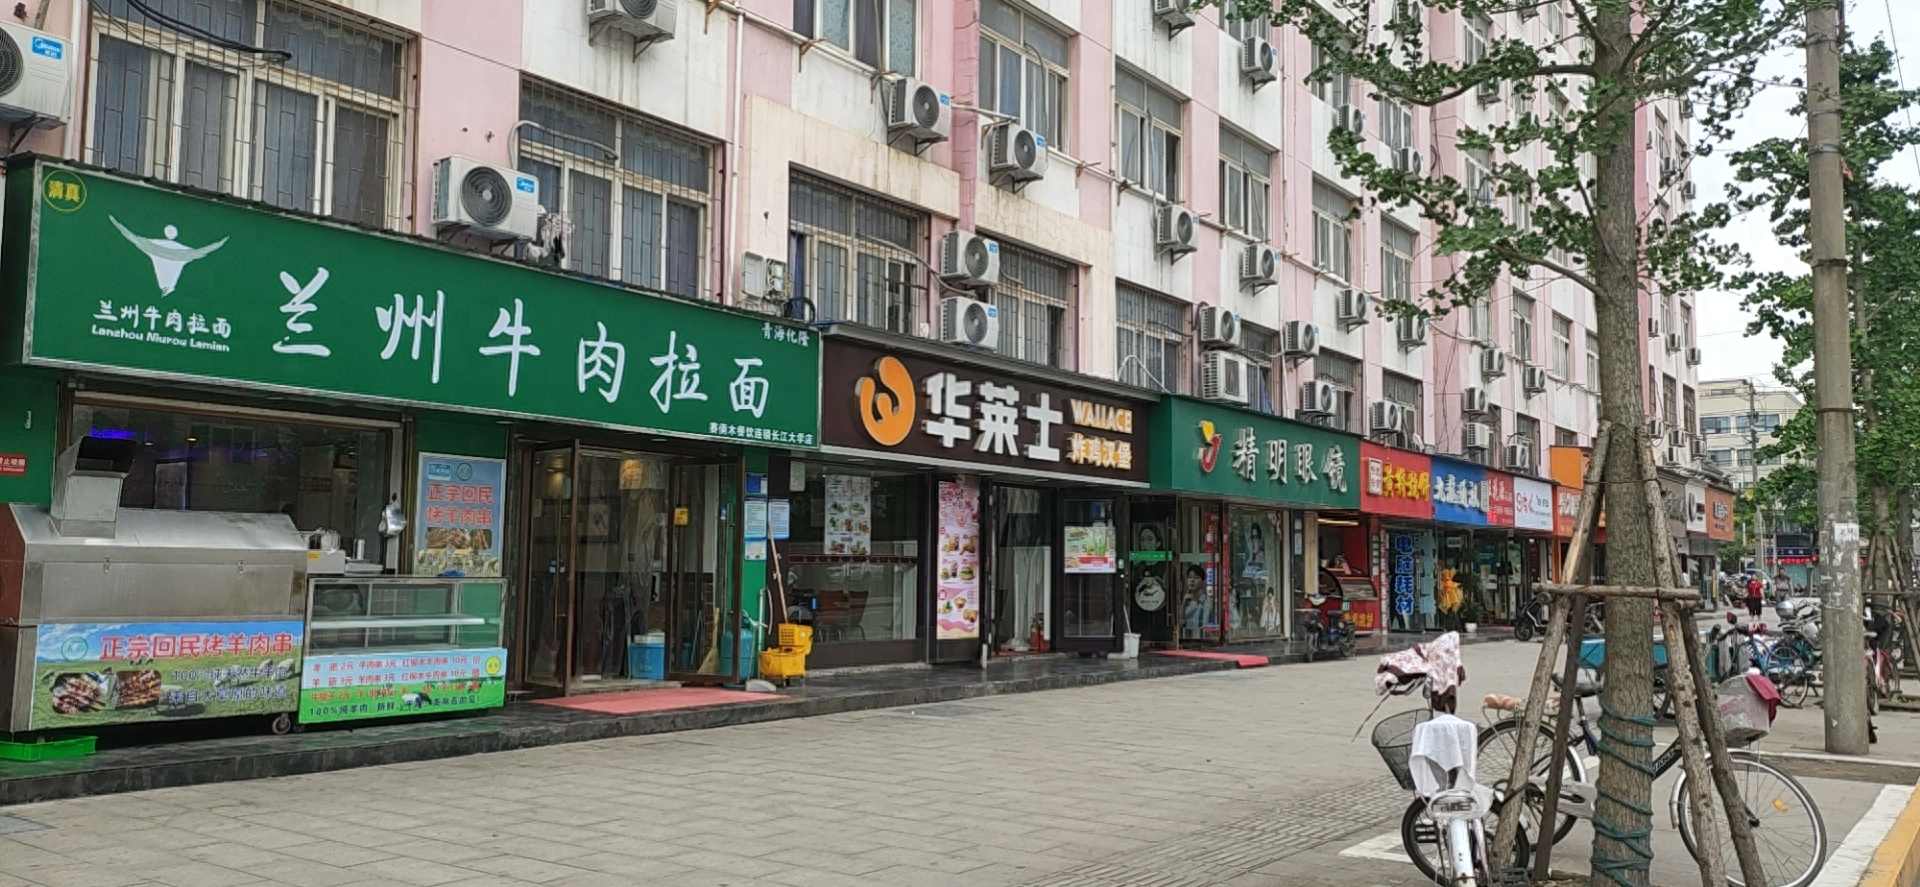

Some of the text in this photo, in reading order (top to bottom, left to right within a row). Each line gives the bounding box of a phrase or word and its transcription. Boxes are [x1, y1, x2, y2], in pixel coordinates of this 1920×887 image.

[47, 178, 81, 203] 清真
[92, 299, 232, 339] 兰州牛肉拉面
[91, 324, 231, 353] Lanzhou Niurou Lamian
[272, 266, 770, 418] 兰州牛肉拉面
[761, 321, 811, 348] 青海化隆
[924, 371, 1064, 463] 华莱士
[1070, 398, 1134, 435] WALLACE
[1069, 432, 1133, 471] 炸鸡汉堡
[1231, 426, 1348, 493] 精明眼镜
[427, 482, 493, 504] 正宗回民
[426, 506, 493, 526] 烤羊肉串
[1395, 535, 1414, 616] 电脑耗材
[99, 632, 293, 661] 正宗回民烤羊肉串
[171, 665, 288, 682] 100%纯天然牛羊肉
[358, 659, 383, 670] 牛肉串
[384, 658, 397, 668] 3元
[451, 655, 468, 664] 10元
[357, 674, 382, 686] 羊肉串
[384, 673, 397, 683] 3元
[450, 669, 467, 678] 10元
[168, 684, 287, 704] 来自大草原的味道
[309, 703, 369, 717] 100%纯羊肉
